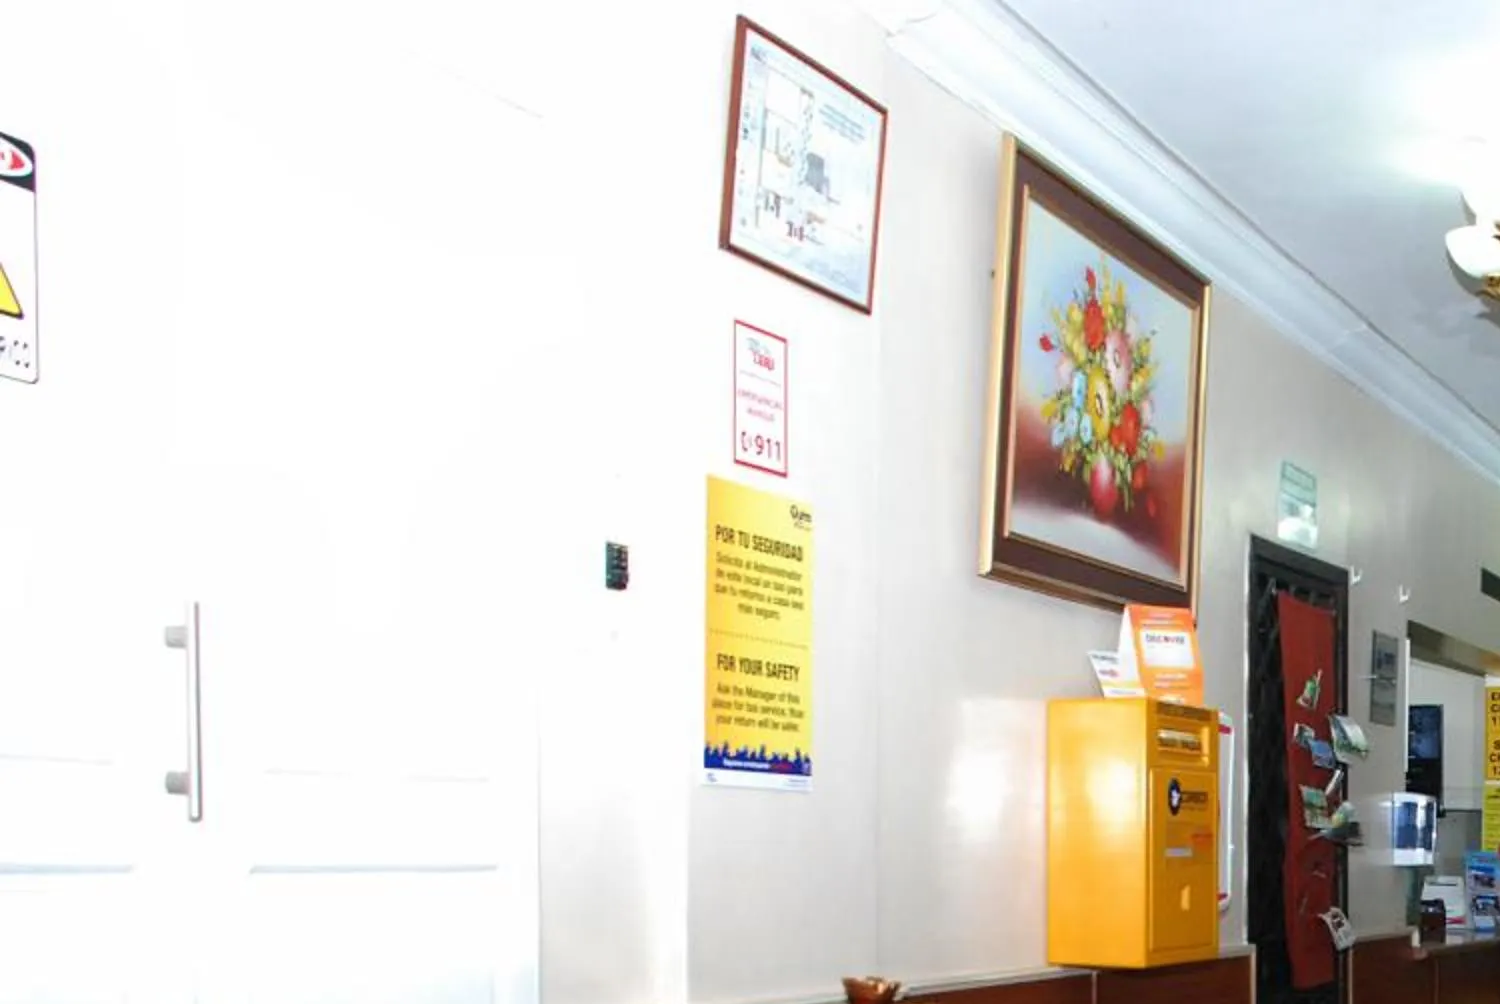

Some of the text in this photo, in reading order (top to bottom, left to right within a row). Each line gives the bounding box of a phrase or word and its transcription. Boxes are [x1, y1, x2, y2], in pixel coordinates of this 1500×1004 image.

[755, 434, 781, 461] 911
[715, 523, 803, 562] POR TU SEGURIDAD
[716, 652, 801, 682] FOR YOUR SAFETY
